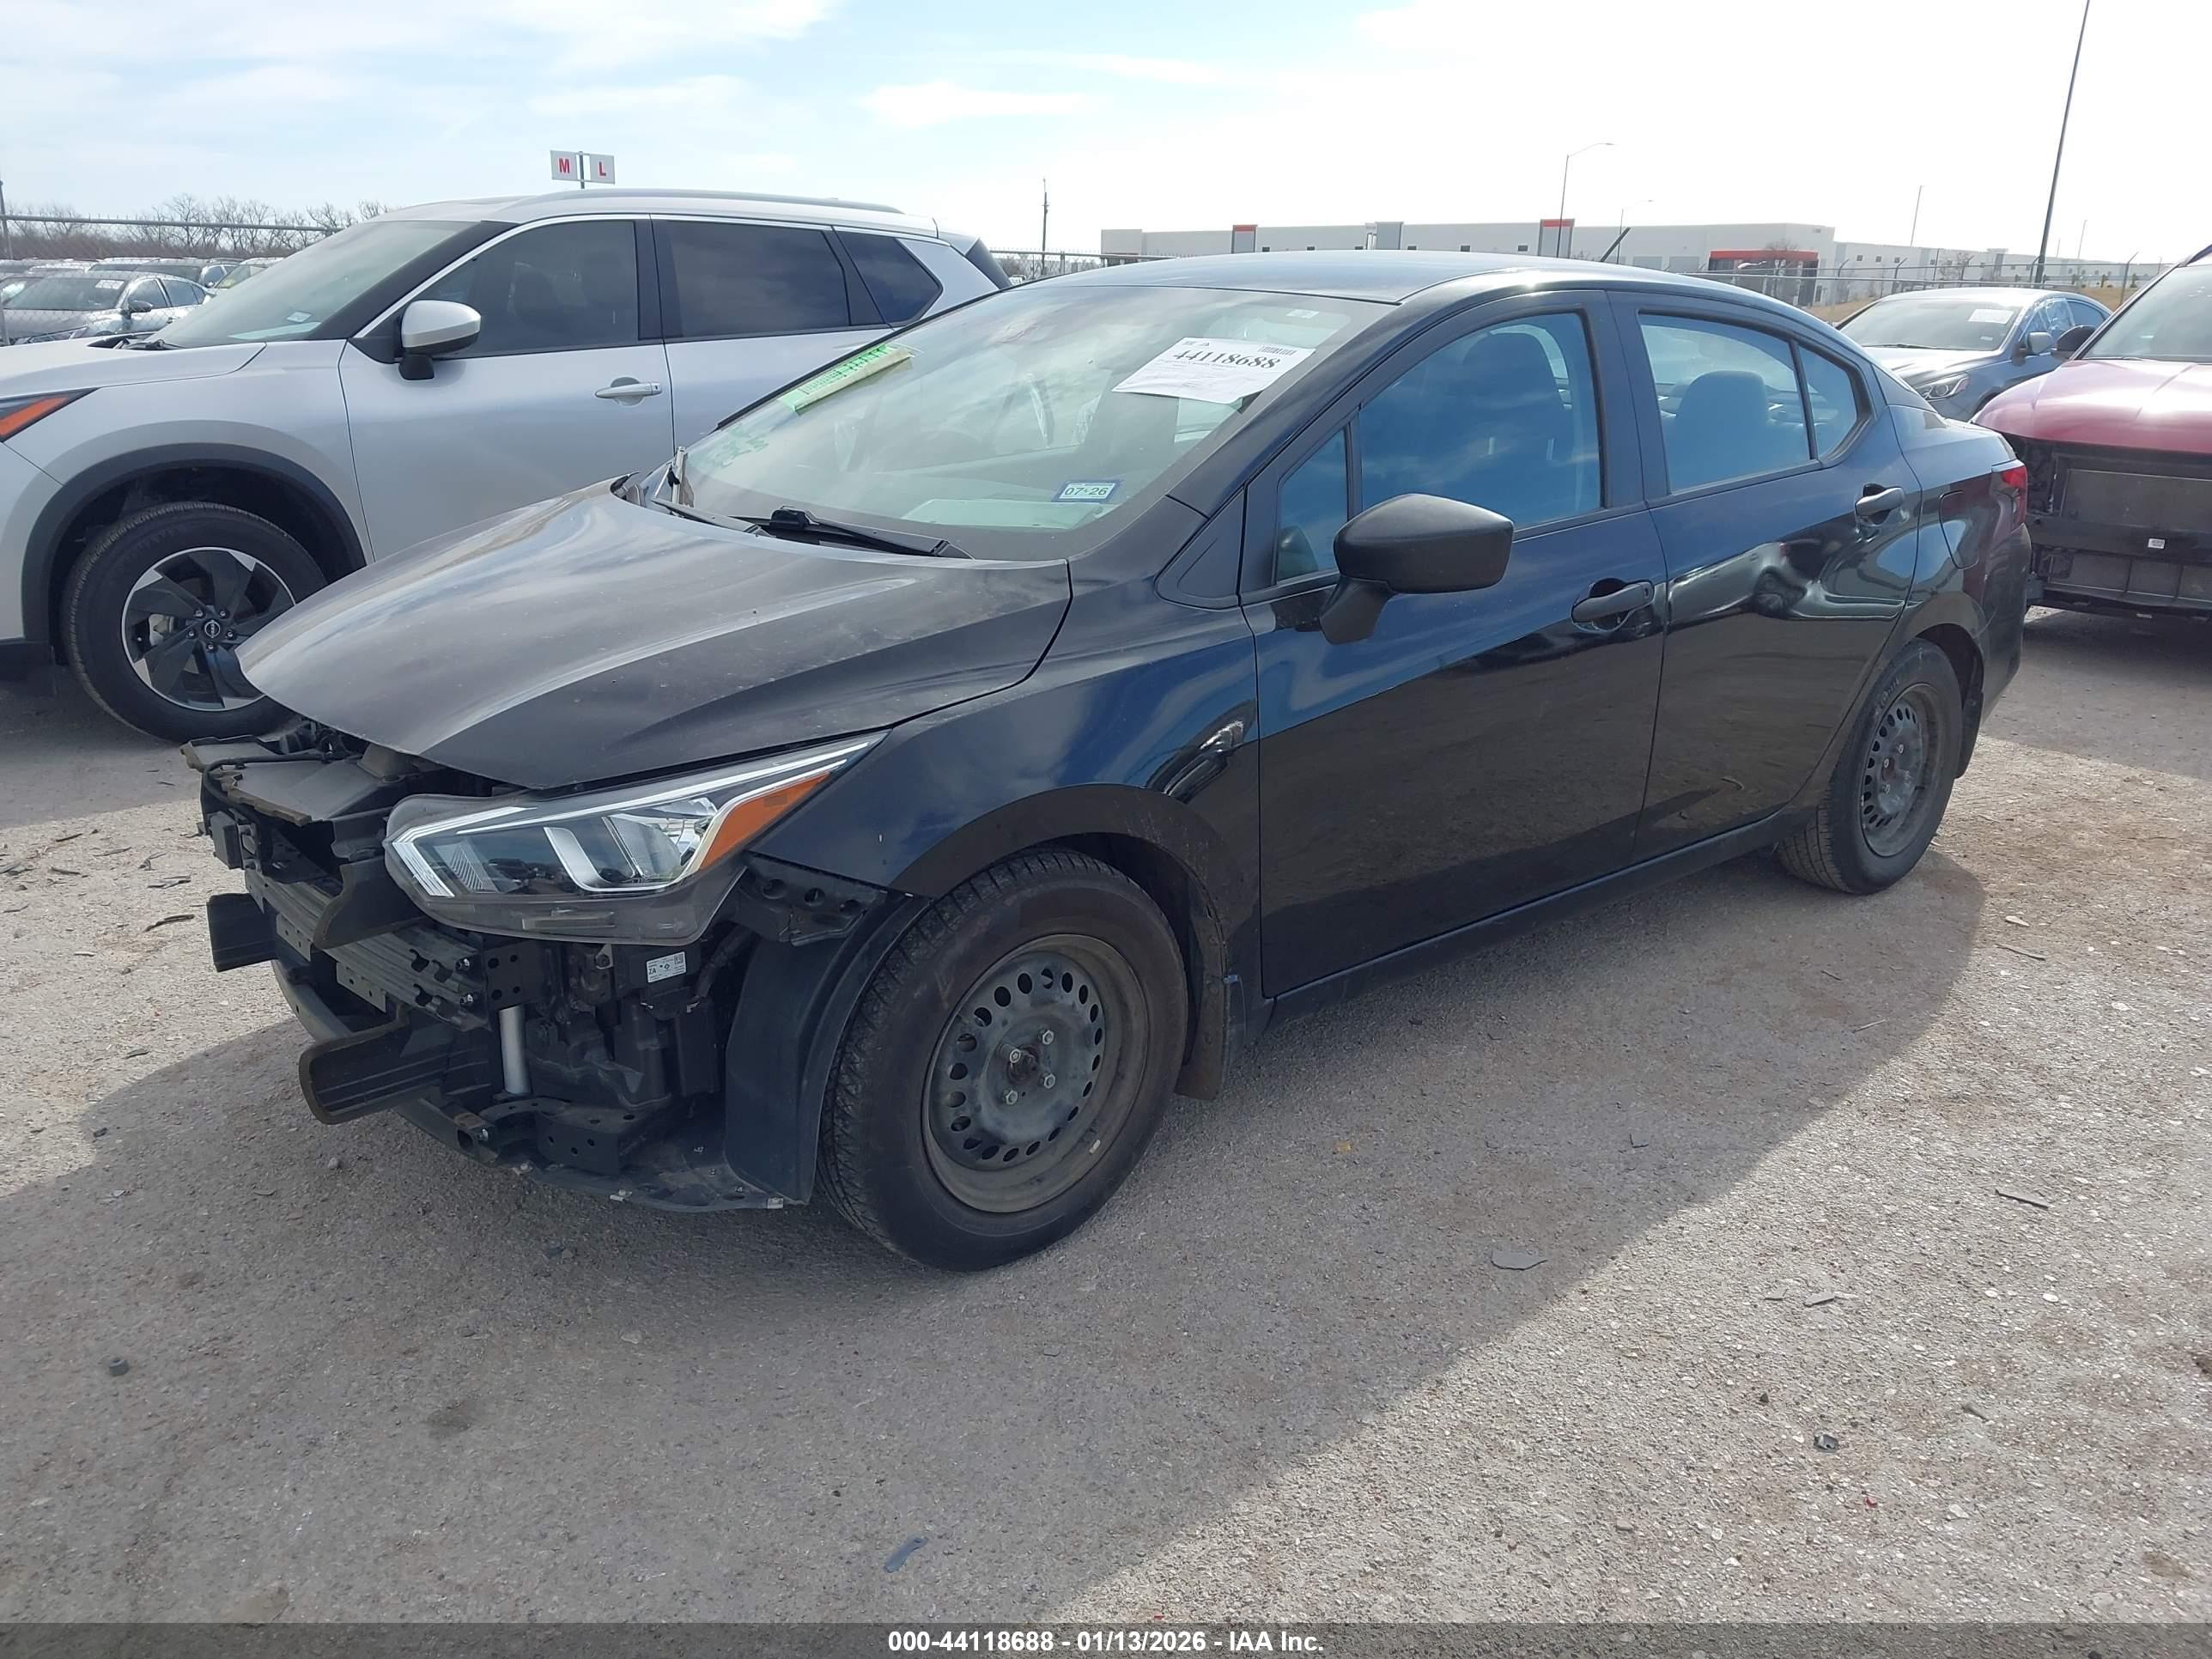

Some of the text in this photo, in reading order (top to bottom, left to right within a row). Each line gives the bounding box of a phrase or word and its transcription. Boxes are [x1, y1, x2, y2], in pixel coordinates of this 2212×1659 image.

[558, 157, 570, 174] M
[599, 161, 607, 177] L
[1173, 349, 1281, 369] 44118688
[1064, 487, 1109, 495] 07 26
